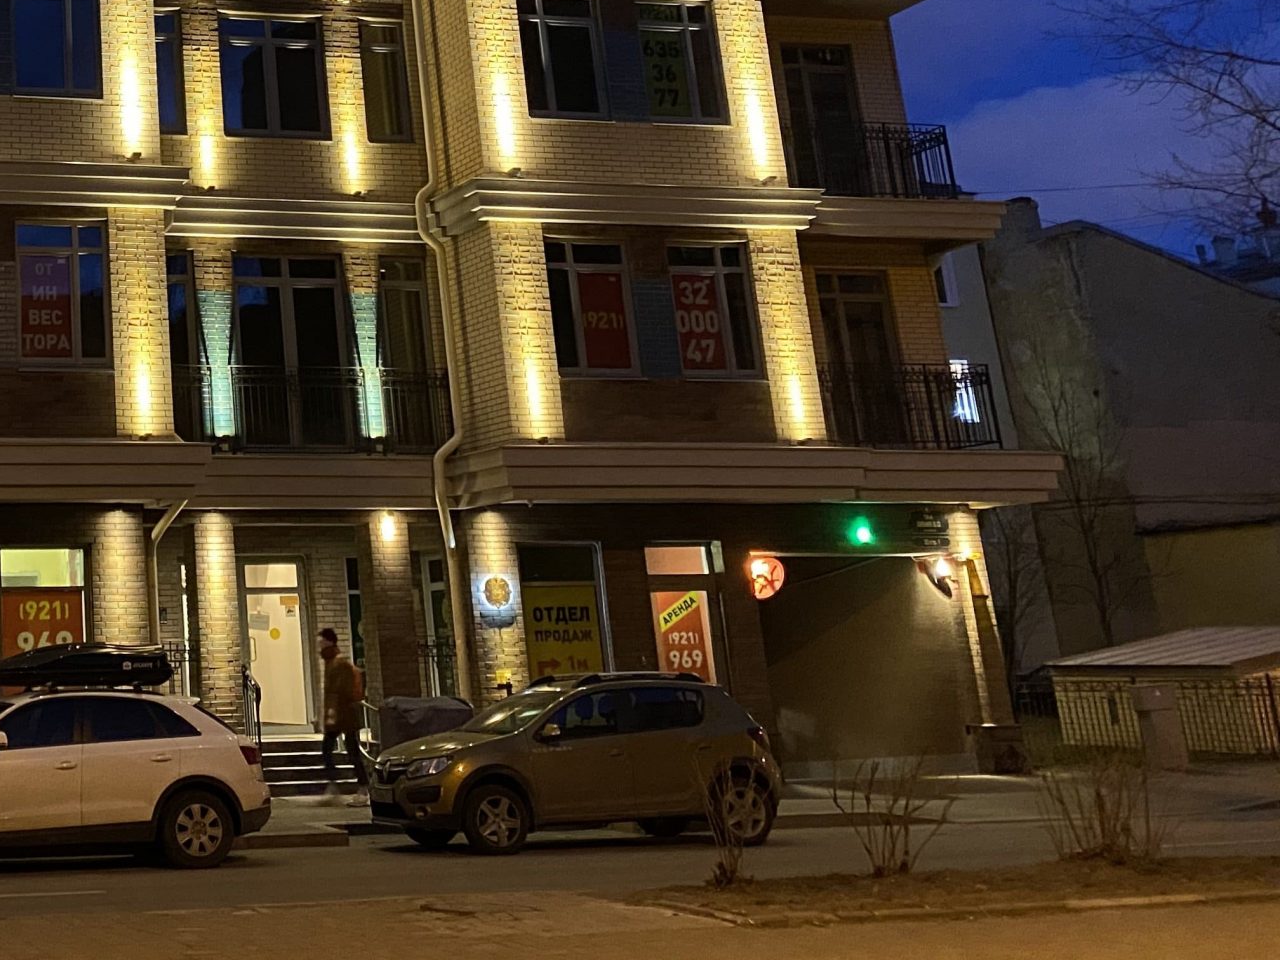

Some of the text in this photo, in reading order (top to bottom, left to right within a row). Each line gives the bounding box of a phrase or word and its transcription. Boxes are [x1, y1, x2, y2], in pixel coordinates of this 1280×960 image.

[644, 40, 680, 58] 635
[653, 63, 677, 82] 36
[654, 87, 679, 107] 77
[35, 263, 53, 276] ОТ
[32, 285, 57, 300] ИН
[680, 281, 710, 304] 32
[29, 309, 63, 325] ВЕС
[676, 310, 720, 334] 000
[23, 333, 71, 351] ТОРА
[687, 339, 716, 362] 47
[19, 600, 70, 621] (921)
[533, 606, 591, 625] ОТДЕЛ
[662, 596, 697, 626] АРЕНДА
[534, 629, 593, 644] ПРОДАЖ
[668, 632, 699, 645] (921)
[669, 649, 703, 669] 969
